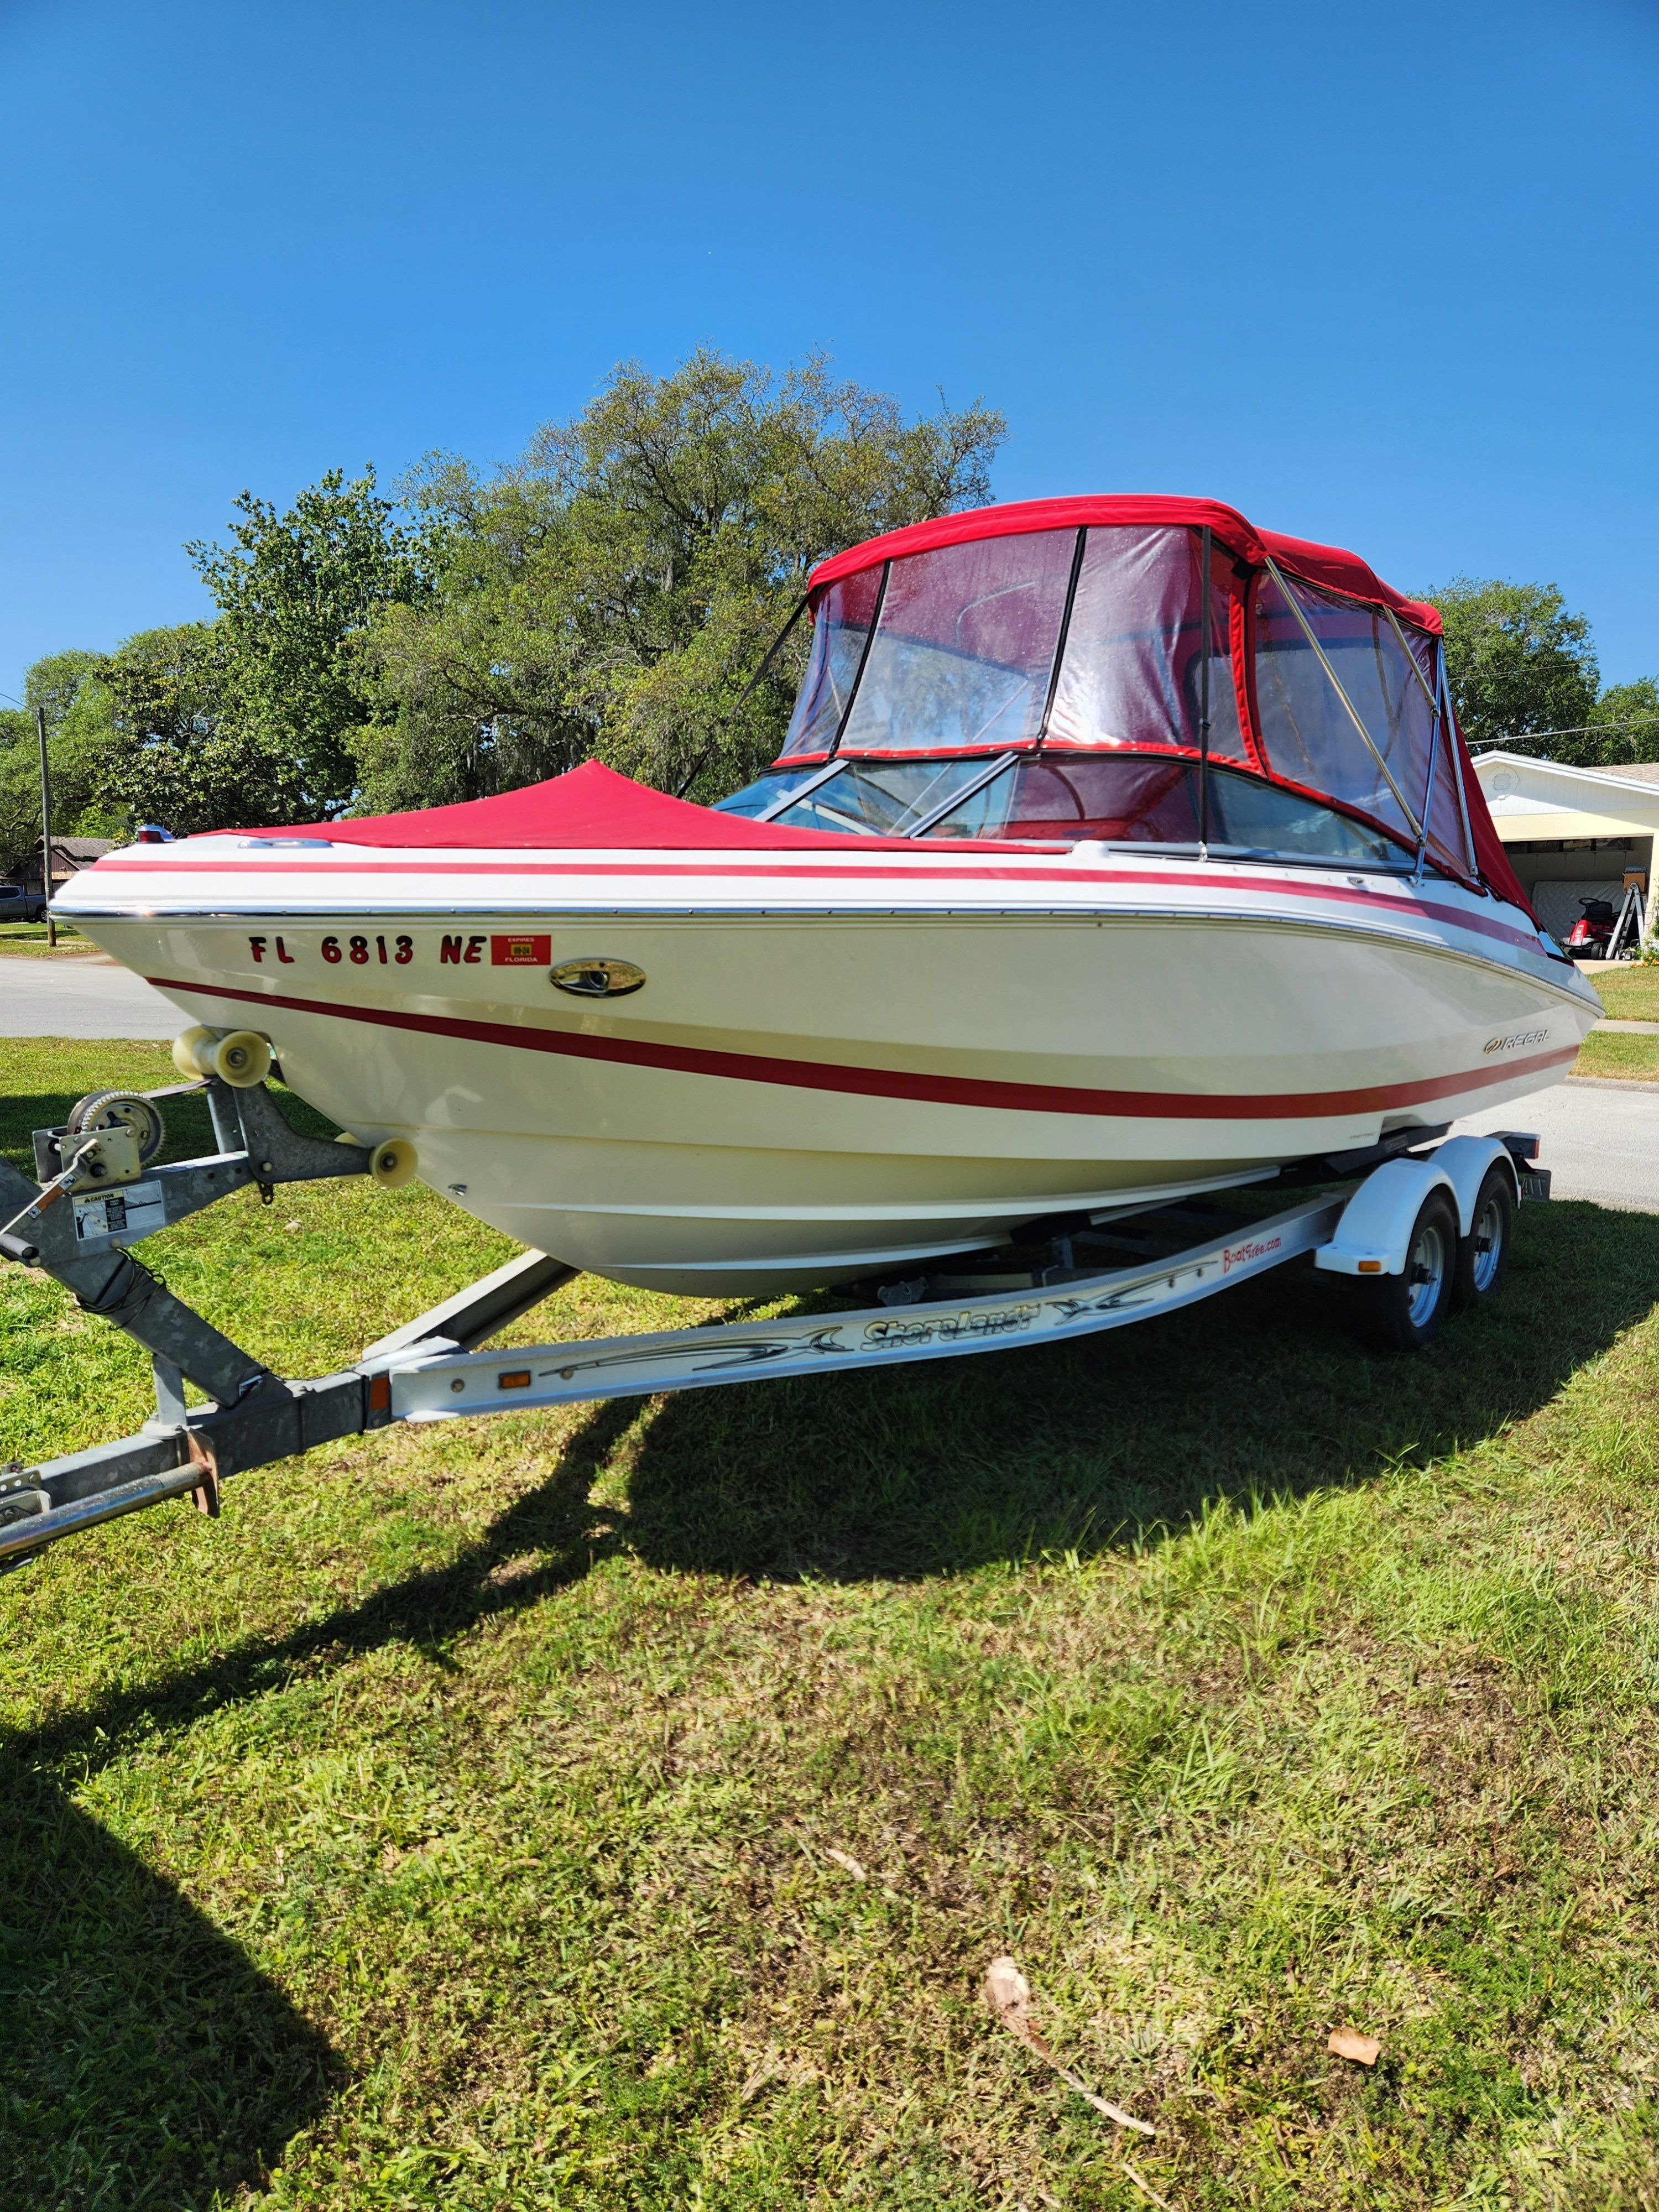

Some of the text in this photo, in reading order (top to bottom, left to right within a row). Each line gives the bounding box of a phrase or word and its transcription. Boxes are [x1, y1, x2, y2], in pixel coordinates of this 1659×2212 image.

[249, 935, 487, 964] FL 6813 NE
[1500, 1029, 1550, 1050] REGAL
[90, 1193, 114, 1202] CAUTION
